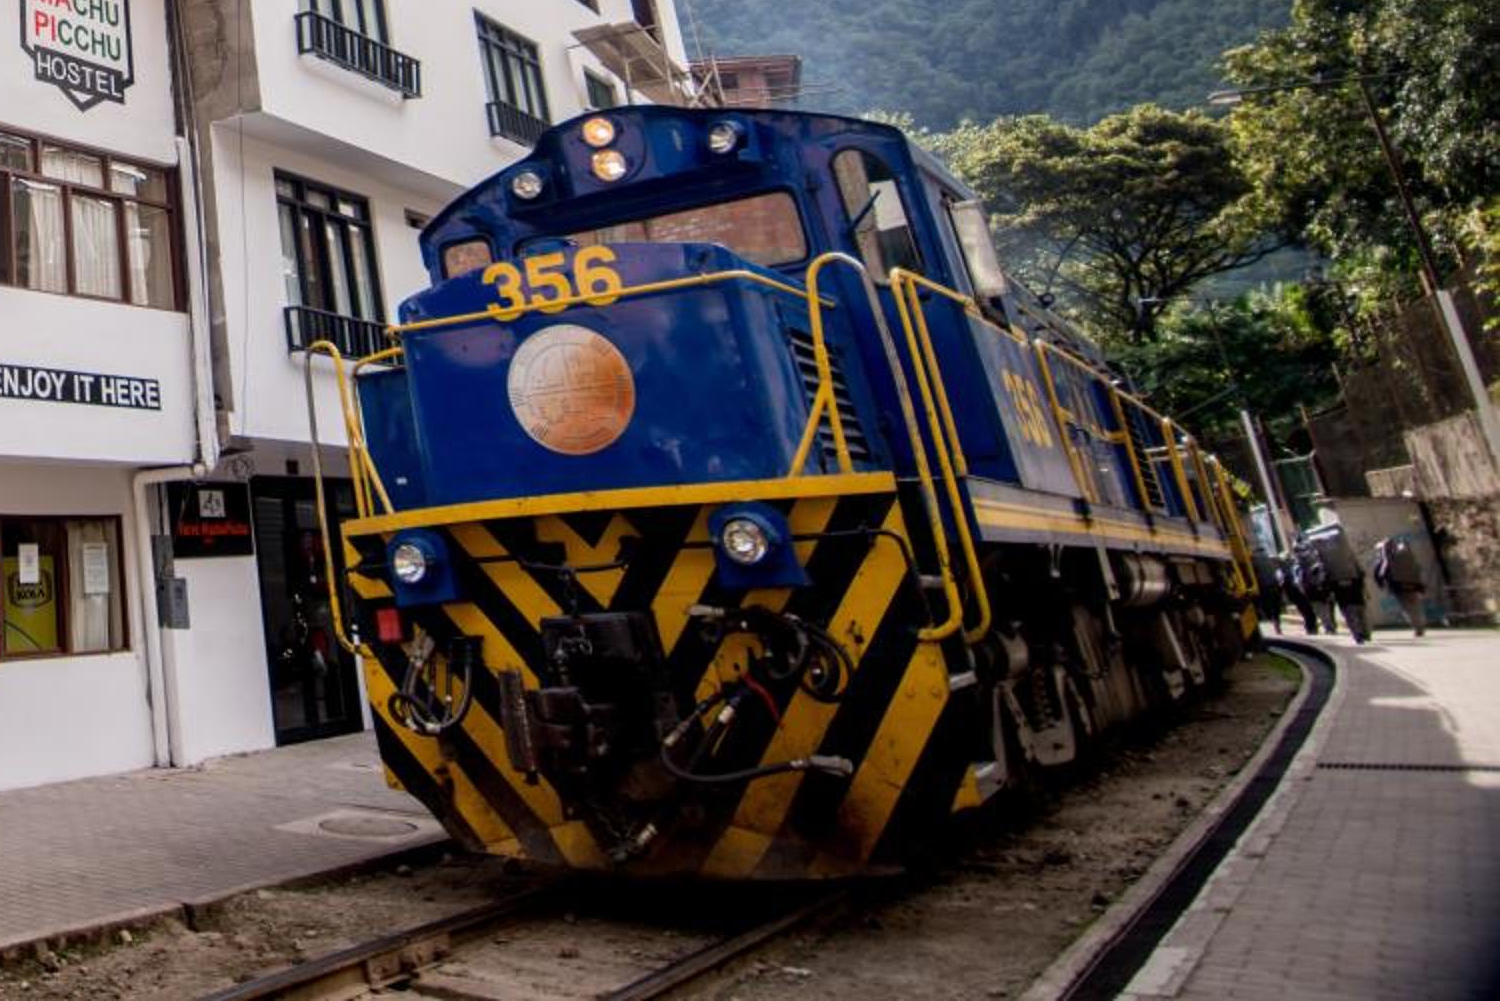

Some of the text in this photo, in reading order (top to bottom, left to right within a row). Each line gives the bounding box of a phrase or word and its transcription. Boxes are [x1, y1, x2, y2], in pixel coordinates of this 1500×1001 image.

[35, 11, 121, 61] PICCHU
[38, 52, 122, 97] HOSTEL
[481, 245, 622, 323] 356
[72, 374, 96, 402] IT
[100, 376, 160, 409] HERE
